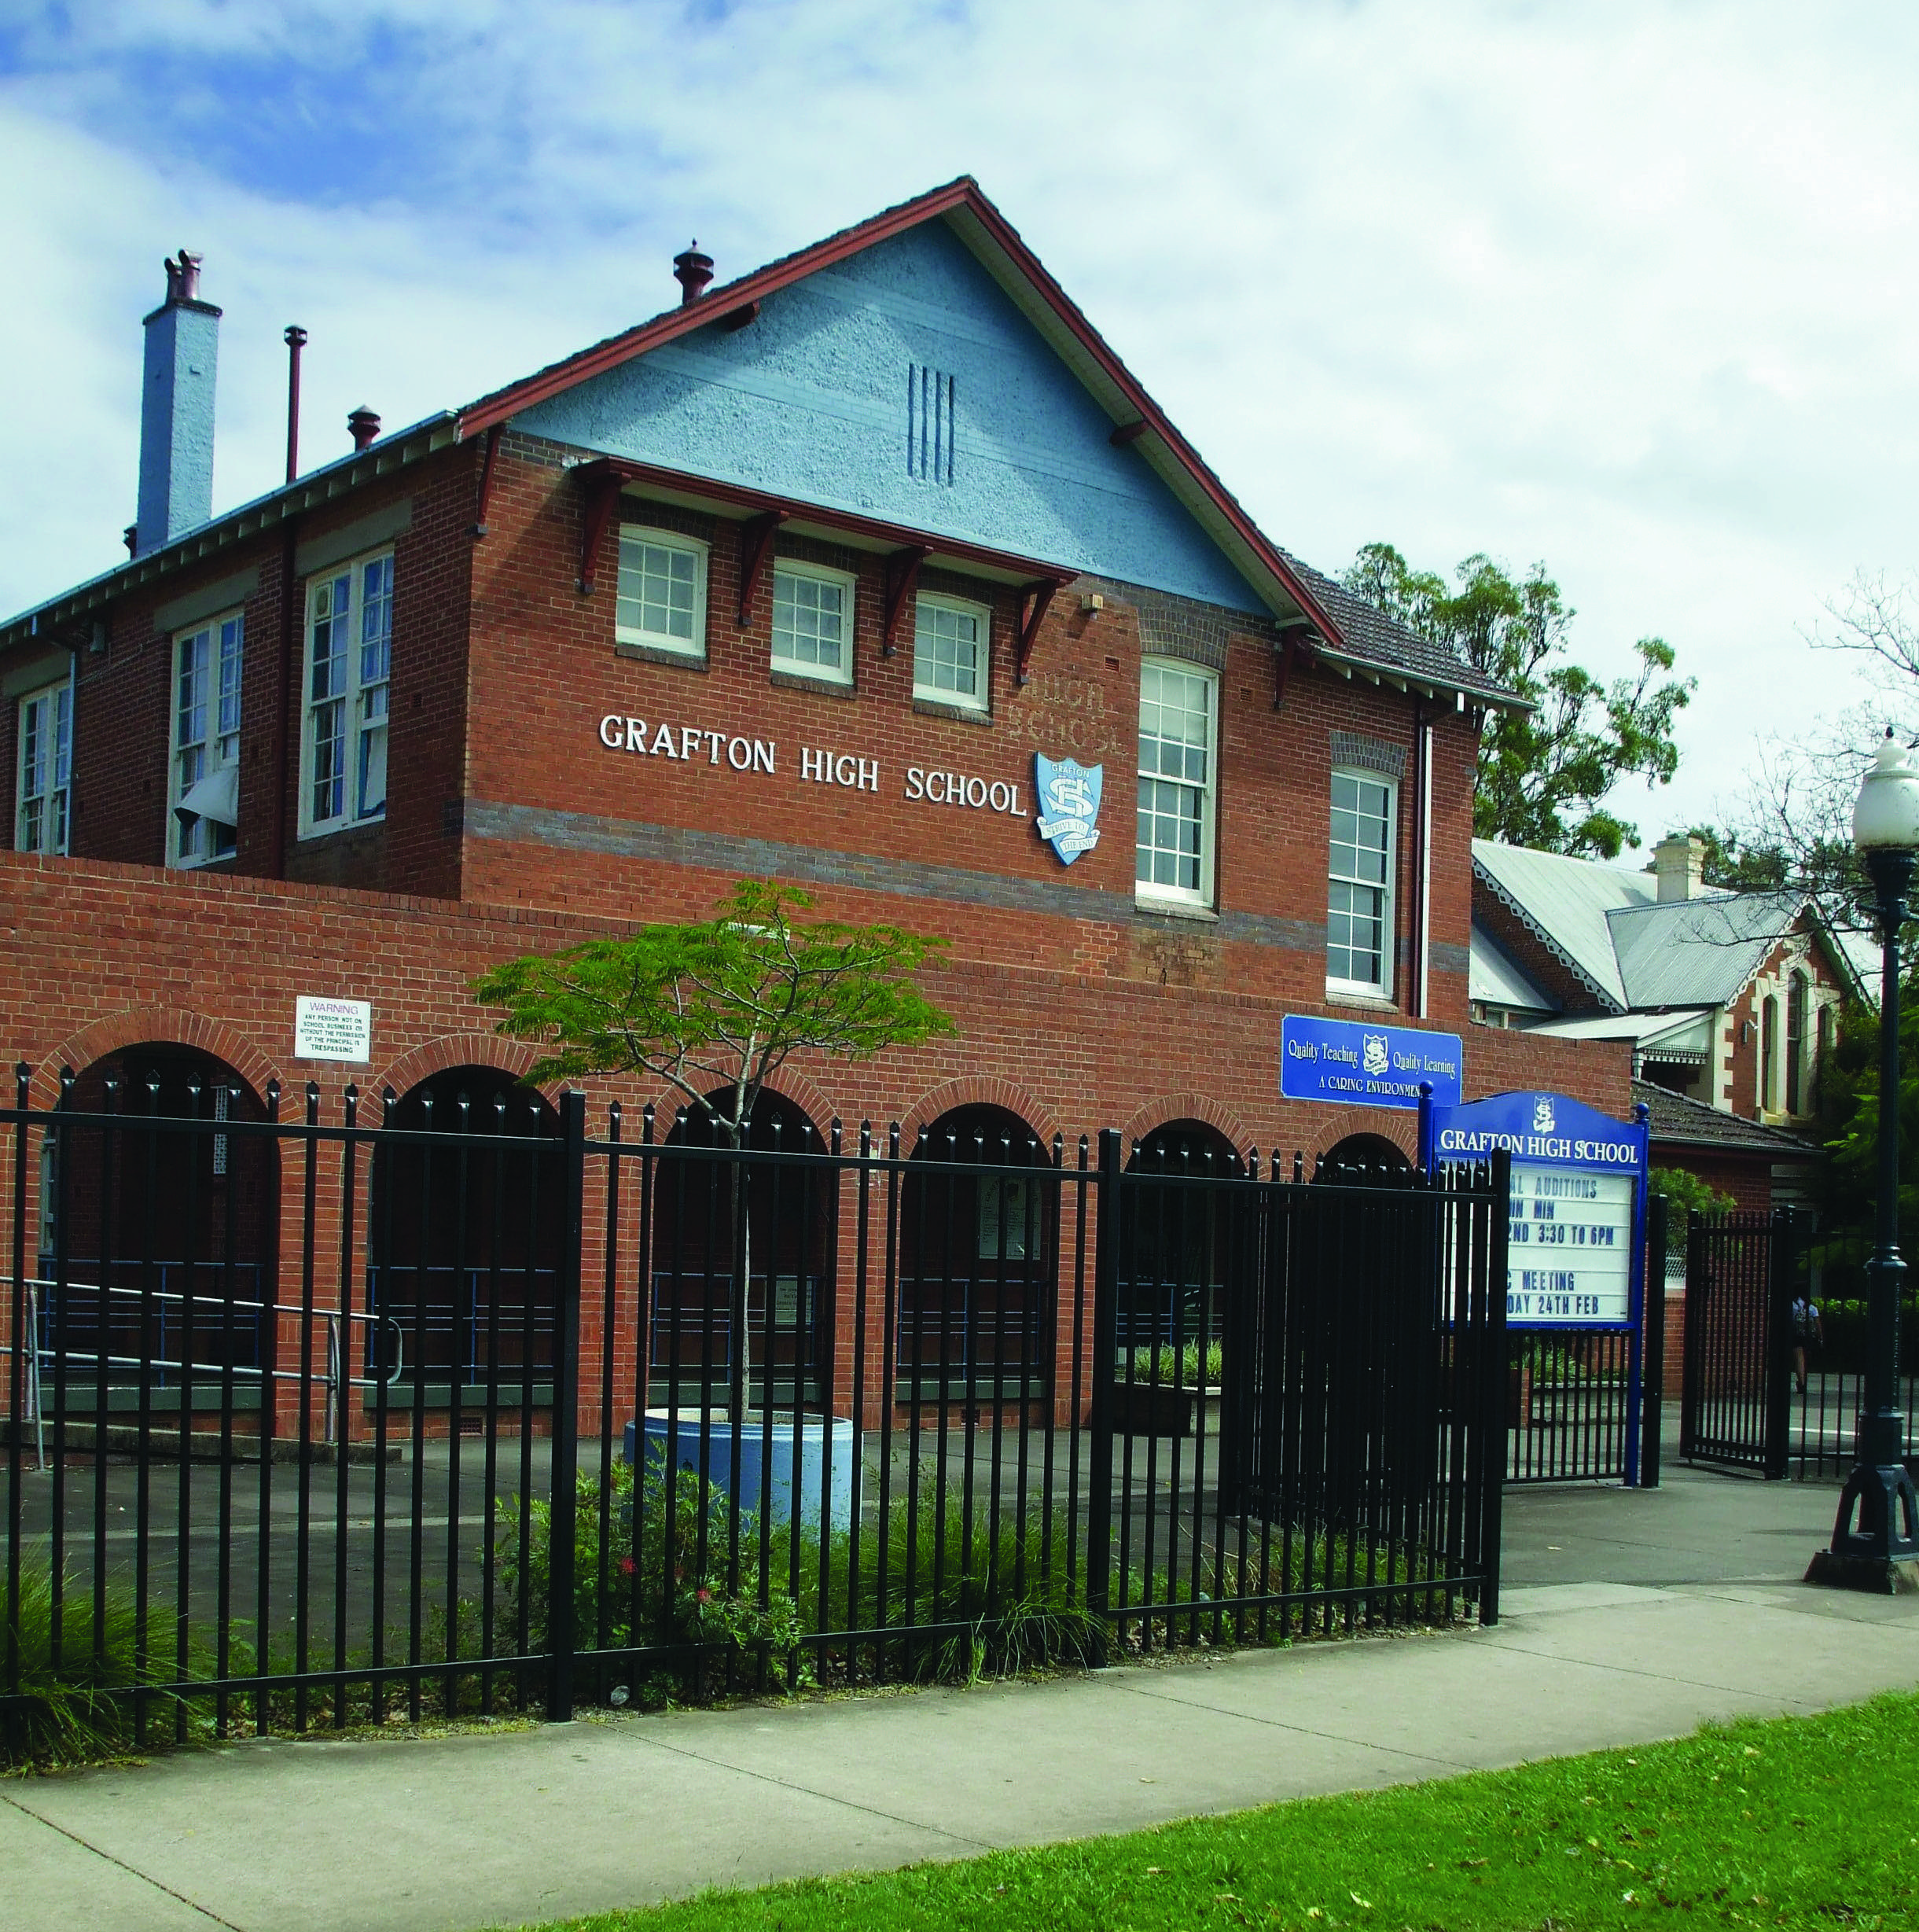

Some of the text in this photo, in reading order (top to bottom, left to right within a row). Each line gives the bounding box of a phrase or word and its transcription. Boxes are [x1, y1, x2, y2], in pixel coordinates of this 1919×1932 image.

[599, 714, 1028, 817] GRAFTON HIGH SCHOOL
[1051, 764, 1090, 778] GRAFTON
[1074, 822, 1086, 830] TO
[1063, 839, 1095, 850] THE END
[309, 1002, 358, 1014] WARNING
[311, 1044, 353, 1054] TRESPASSING
[1288, 1040, 1320, 1064] Quality
[1322, 1043, 1358, 1069] Teaching
[1393, 1052, 1421, 1075] Quality
[1424, 1054, 1455, 1080] Learning
[1318, 1075, 1421, 1098] A CARING ENVIRONMEN
[1440, 1129, 1638, 1164] GRAFTON HIGH SCHOOL
[1535, 1176, 1597, 1198] AUDITIONS
[1539, 1224, 1564, 1244] 3:30
[1572, 1226, 1586, 1245] TO
[1590, 1227, 1614, 1246] 6PM
[1522, 1271, 1575, 1291] MEETING
[1506, 1294, 1598, 1315] DAY 24TH FEB
